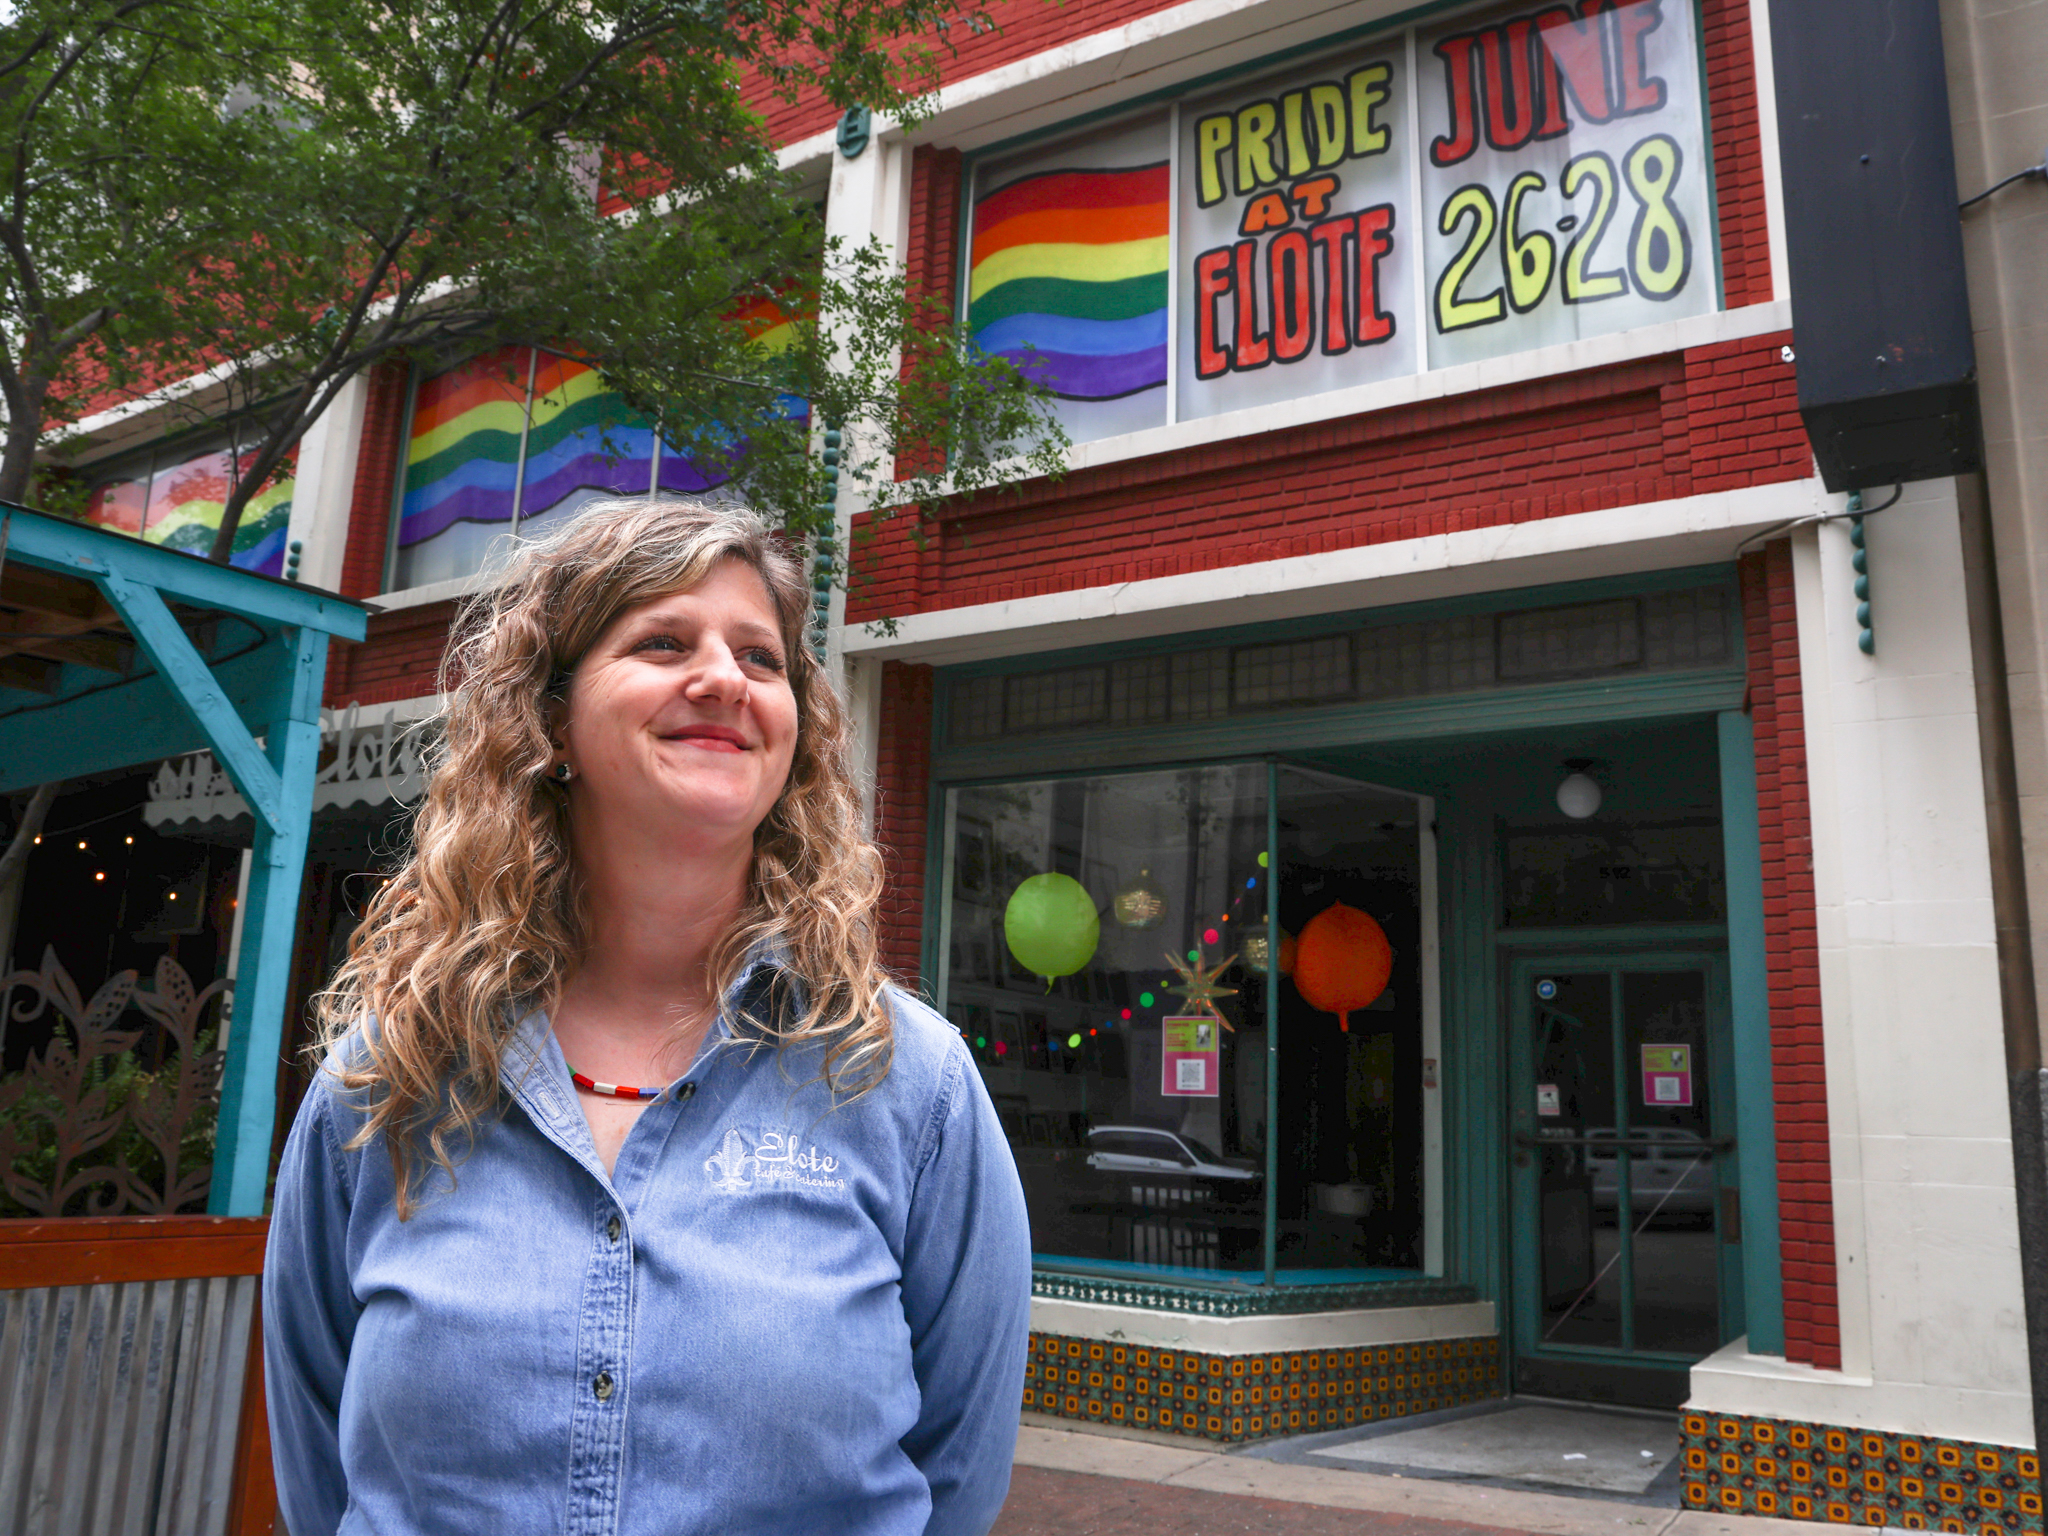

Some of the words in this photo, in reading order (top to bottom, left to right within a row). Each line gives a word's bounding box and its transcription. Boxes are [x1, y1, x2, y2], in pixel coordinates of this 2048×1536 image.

[1195, 61, 1393, 208] PRIDE
[1430, 0, 1667, 168] JUNE
[1238, 173, 1340, 236] AT
[1434, 133, 1692, 334] 26-28
[1194, 203, 1395, 380] ELOTE
[755, 1132, 839, 1172] Elote
[755, 1163, 782, 1181] café
[783, 1165, 796, 1178] &
[796, 1173, 845, 1191] catering
